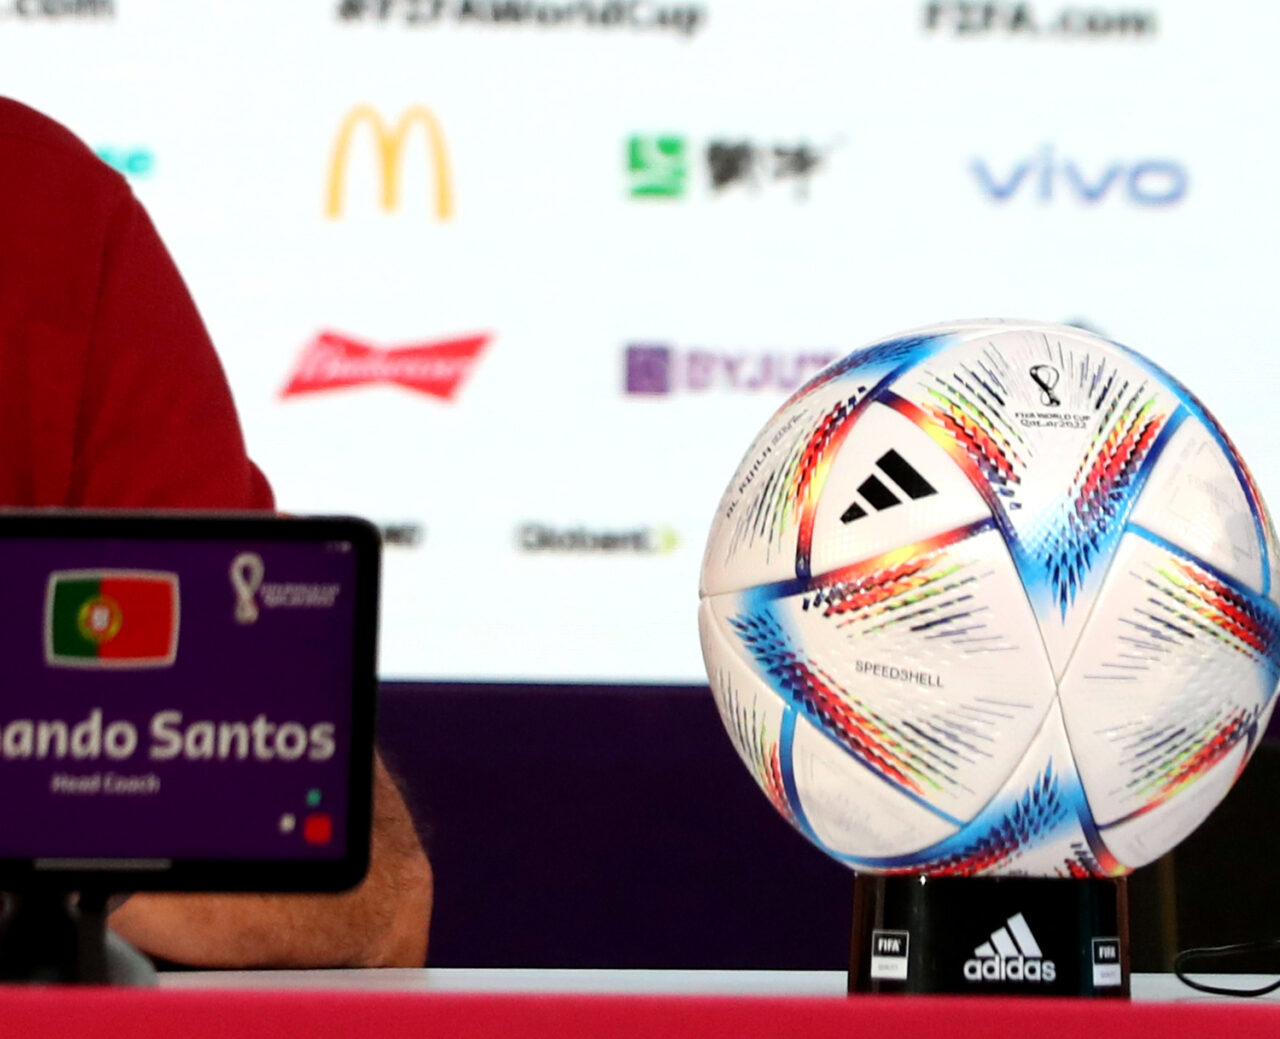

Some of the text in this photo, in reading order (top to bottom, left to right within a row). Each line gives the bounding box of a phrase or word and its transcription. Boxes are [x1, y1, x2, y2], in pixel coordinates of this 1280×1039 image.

[968, 144, 1190, 208] vivo
[855, 660, 944, 688] SPEEDSHELL
[149, 709, 337, 761] Santos
[878, 937, 900, 952] FIFA
[963, 954, 1057, 981] adidas
